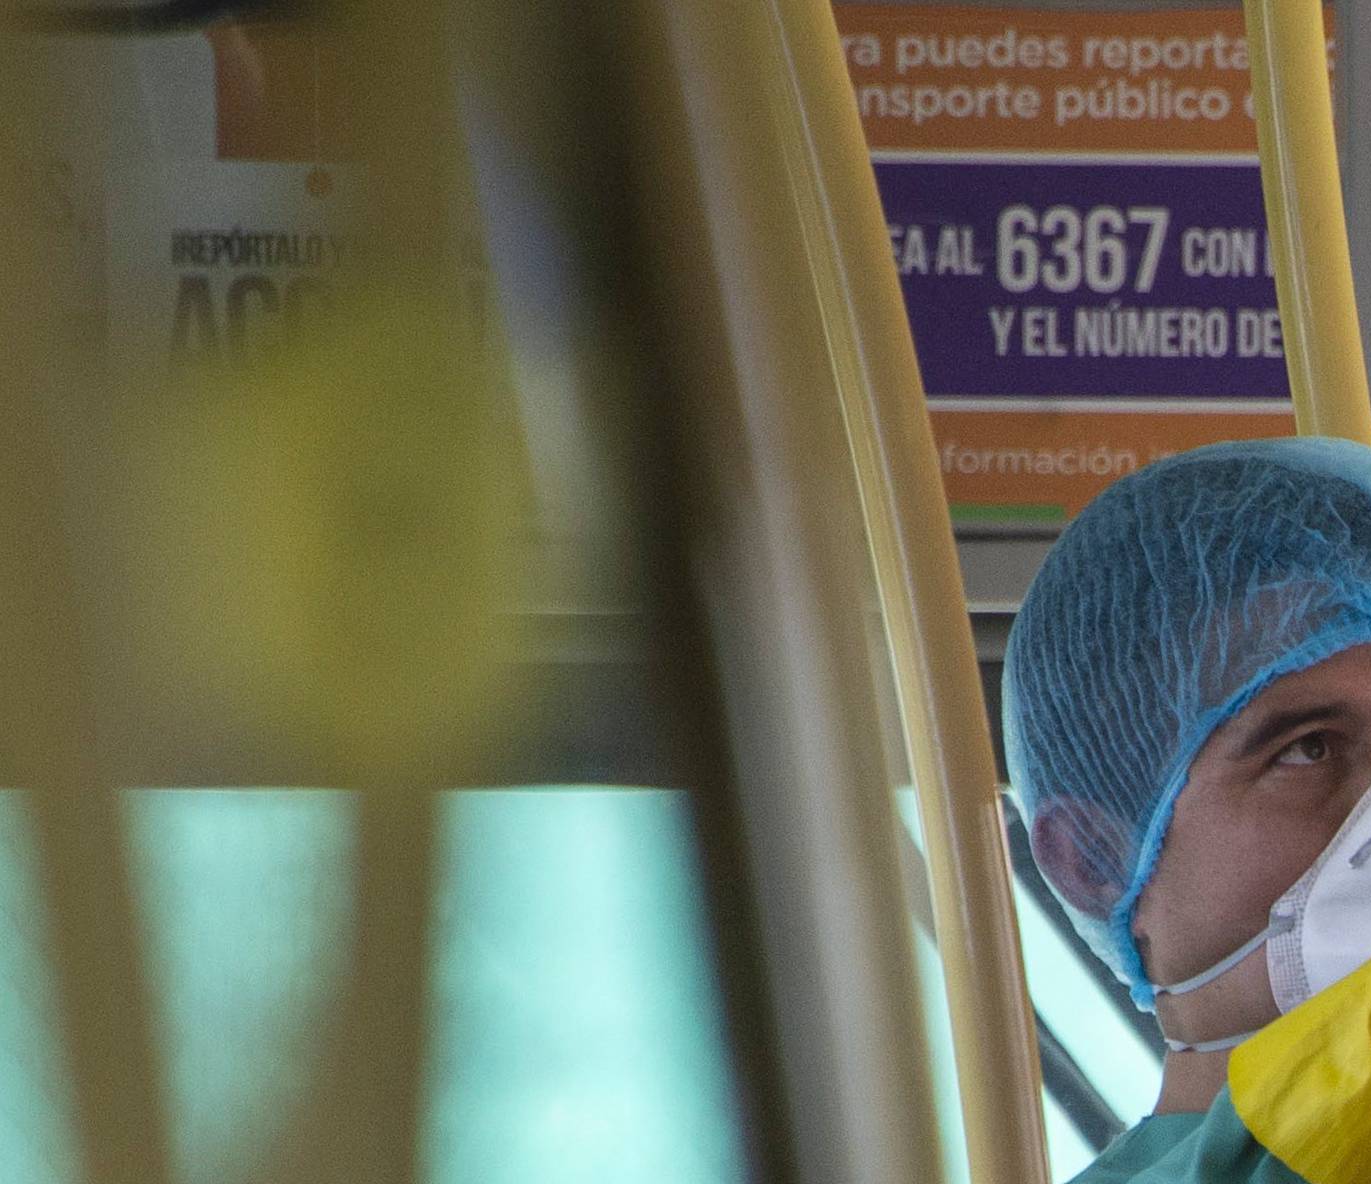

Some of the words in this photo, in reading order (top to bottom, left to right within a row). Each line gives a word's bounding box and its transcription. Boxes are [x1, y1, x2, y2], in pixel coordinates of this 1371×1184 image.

[895, 28, 1069, 74] puedes
[1055, 78, 1231, 127] público
[936, 225, 984, 276] AL
[999, 204, 1171, 294] 6367
[1181, 226, 1255, 278] CON
[989, 306, 1017, 357] Y
[1022, 307, 1068, 358] EL
[1075, 298, 1229, 359] NÚMERO
[1238, 309, 1284, 359] DE
